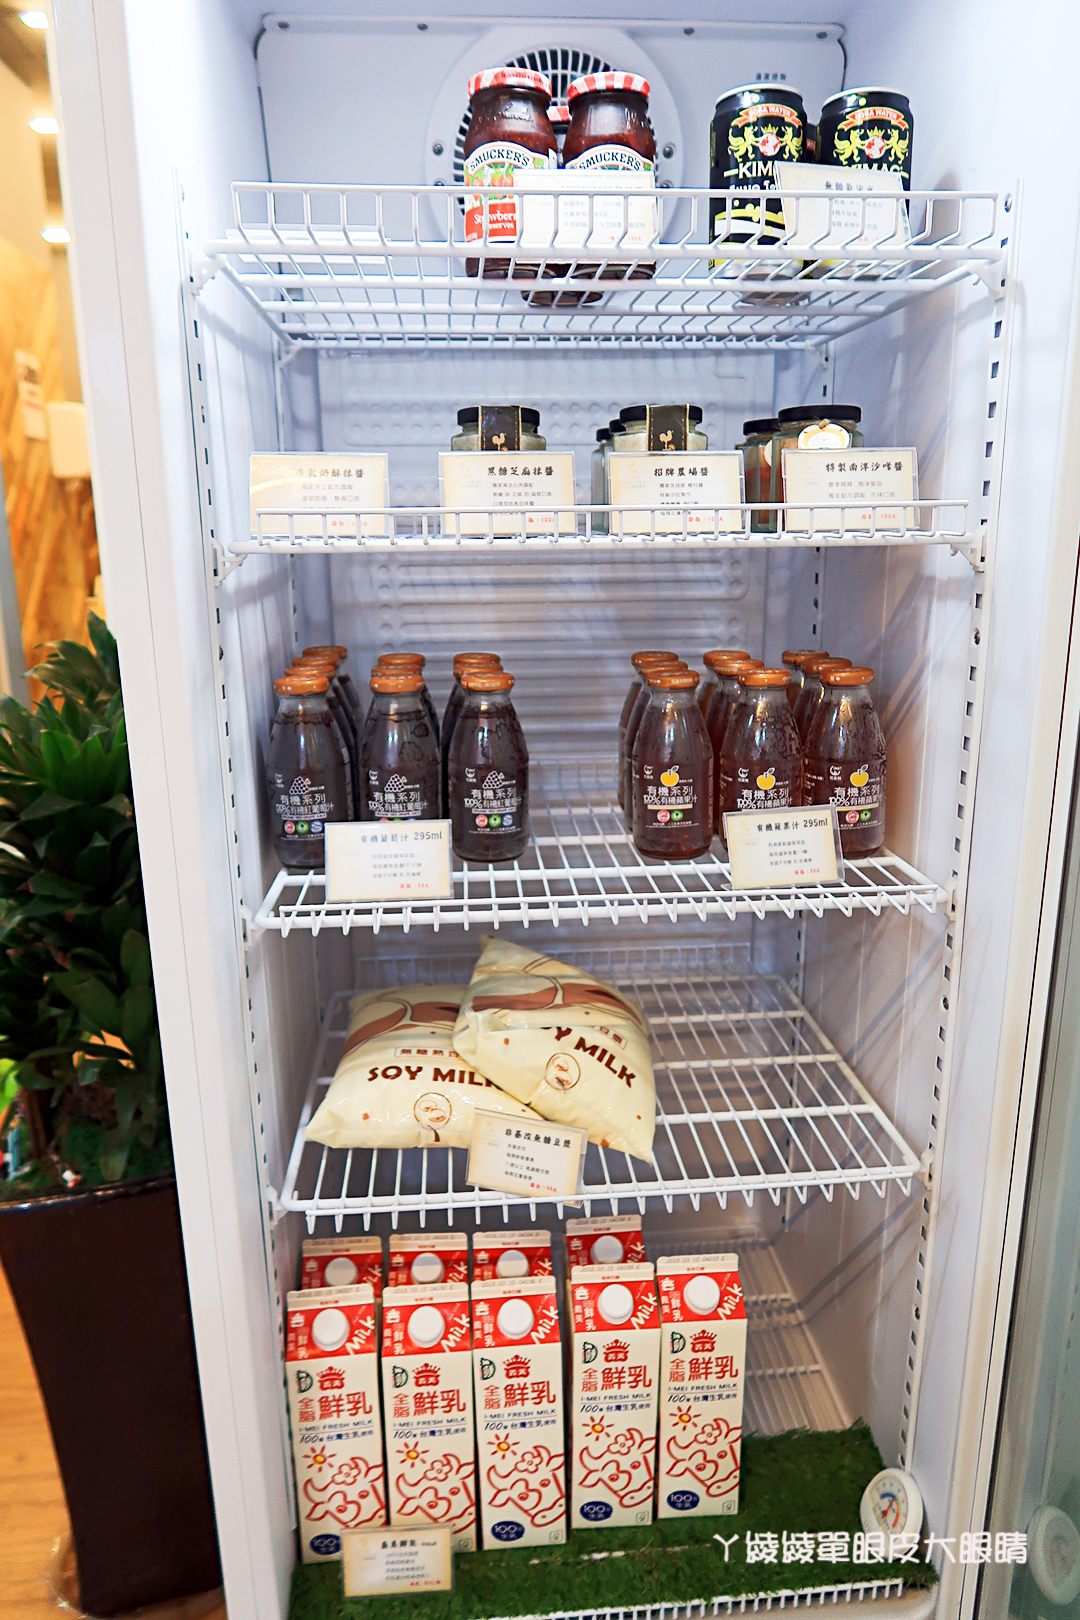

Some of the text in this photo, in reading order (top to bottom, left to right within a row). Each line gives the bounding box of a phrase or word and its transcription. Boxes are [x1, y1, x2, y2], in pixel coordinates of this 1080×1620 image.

[470, 149, 530, 171] SMUCKER'S
[487, 466, 554, 476] 黑糖芝麻抹醬
[653, 466, 709, 477] 招牌農場醬
[373, 791, 420, 802] 有機系列
[470, 787, 516, 799] 有機系列
[647, 785, 693, 796] 有機系列
[741, 788, 789, 800] 有機系列
[834, 784, 880, 797] 有機系列
[280, 793, 326, 805] 有機系列
[757, 818, 828, 832] 有機蘋果汁 295ml
[413, 831, 443, 840] 295ml
[574, 1036, 636, 1088] MILK
[367, 1065, 423, 1082] SOY
[505, 1128, 571, 1149] 非基改無糖豆漿
